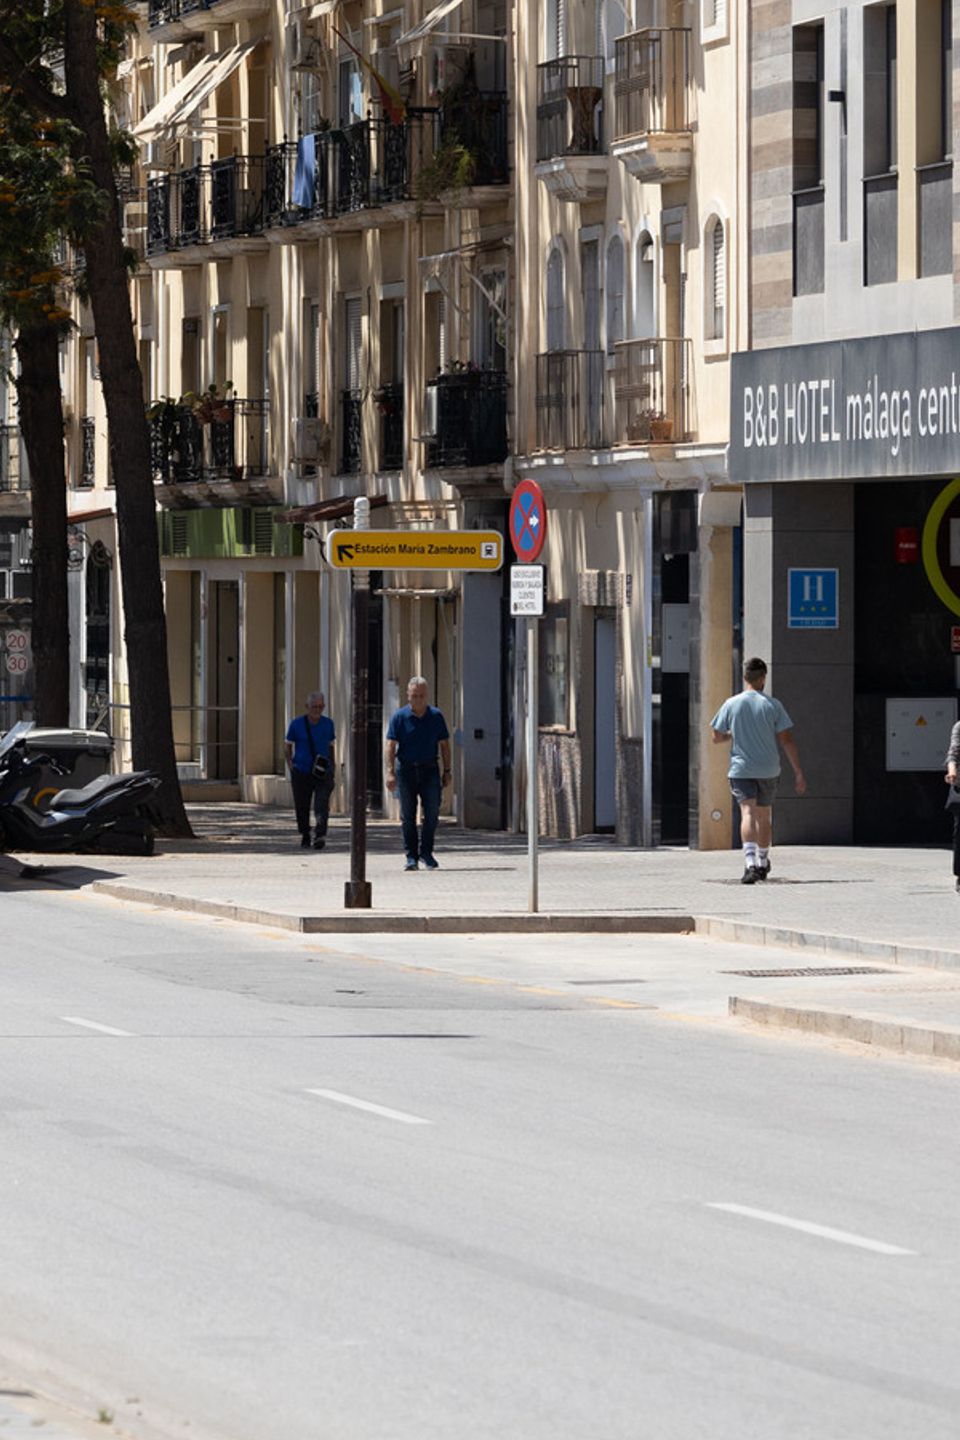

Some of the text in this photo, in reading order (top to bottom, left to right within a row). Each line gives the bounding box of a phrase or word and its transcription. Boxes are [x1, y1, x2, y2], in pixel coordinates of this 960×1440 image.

[744, 385, 779, 447] B&B
[784, 379, 840, 445] HOTEL
[846, 374, 911, 456] málaga
[355, 543, 396, 555] Estación
[427, 543, 477, 555] Zambrano
[8, 633, 27, 648] 20
[8, 656, 27, 671] 30
